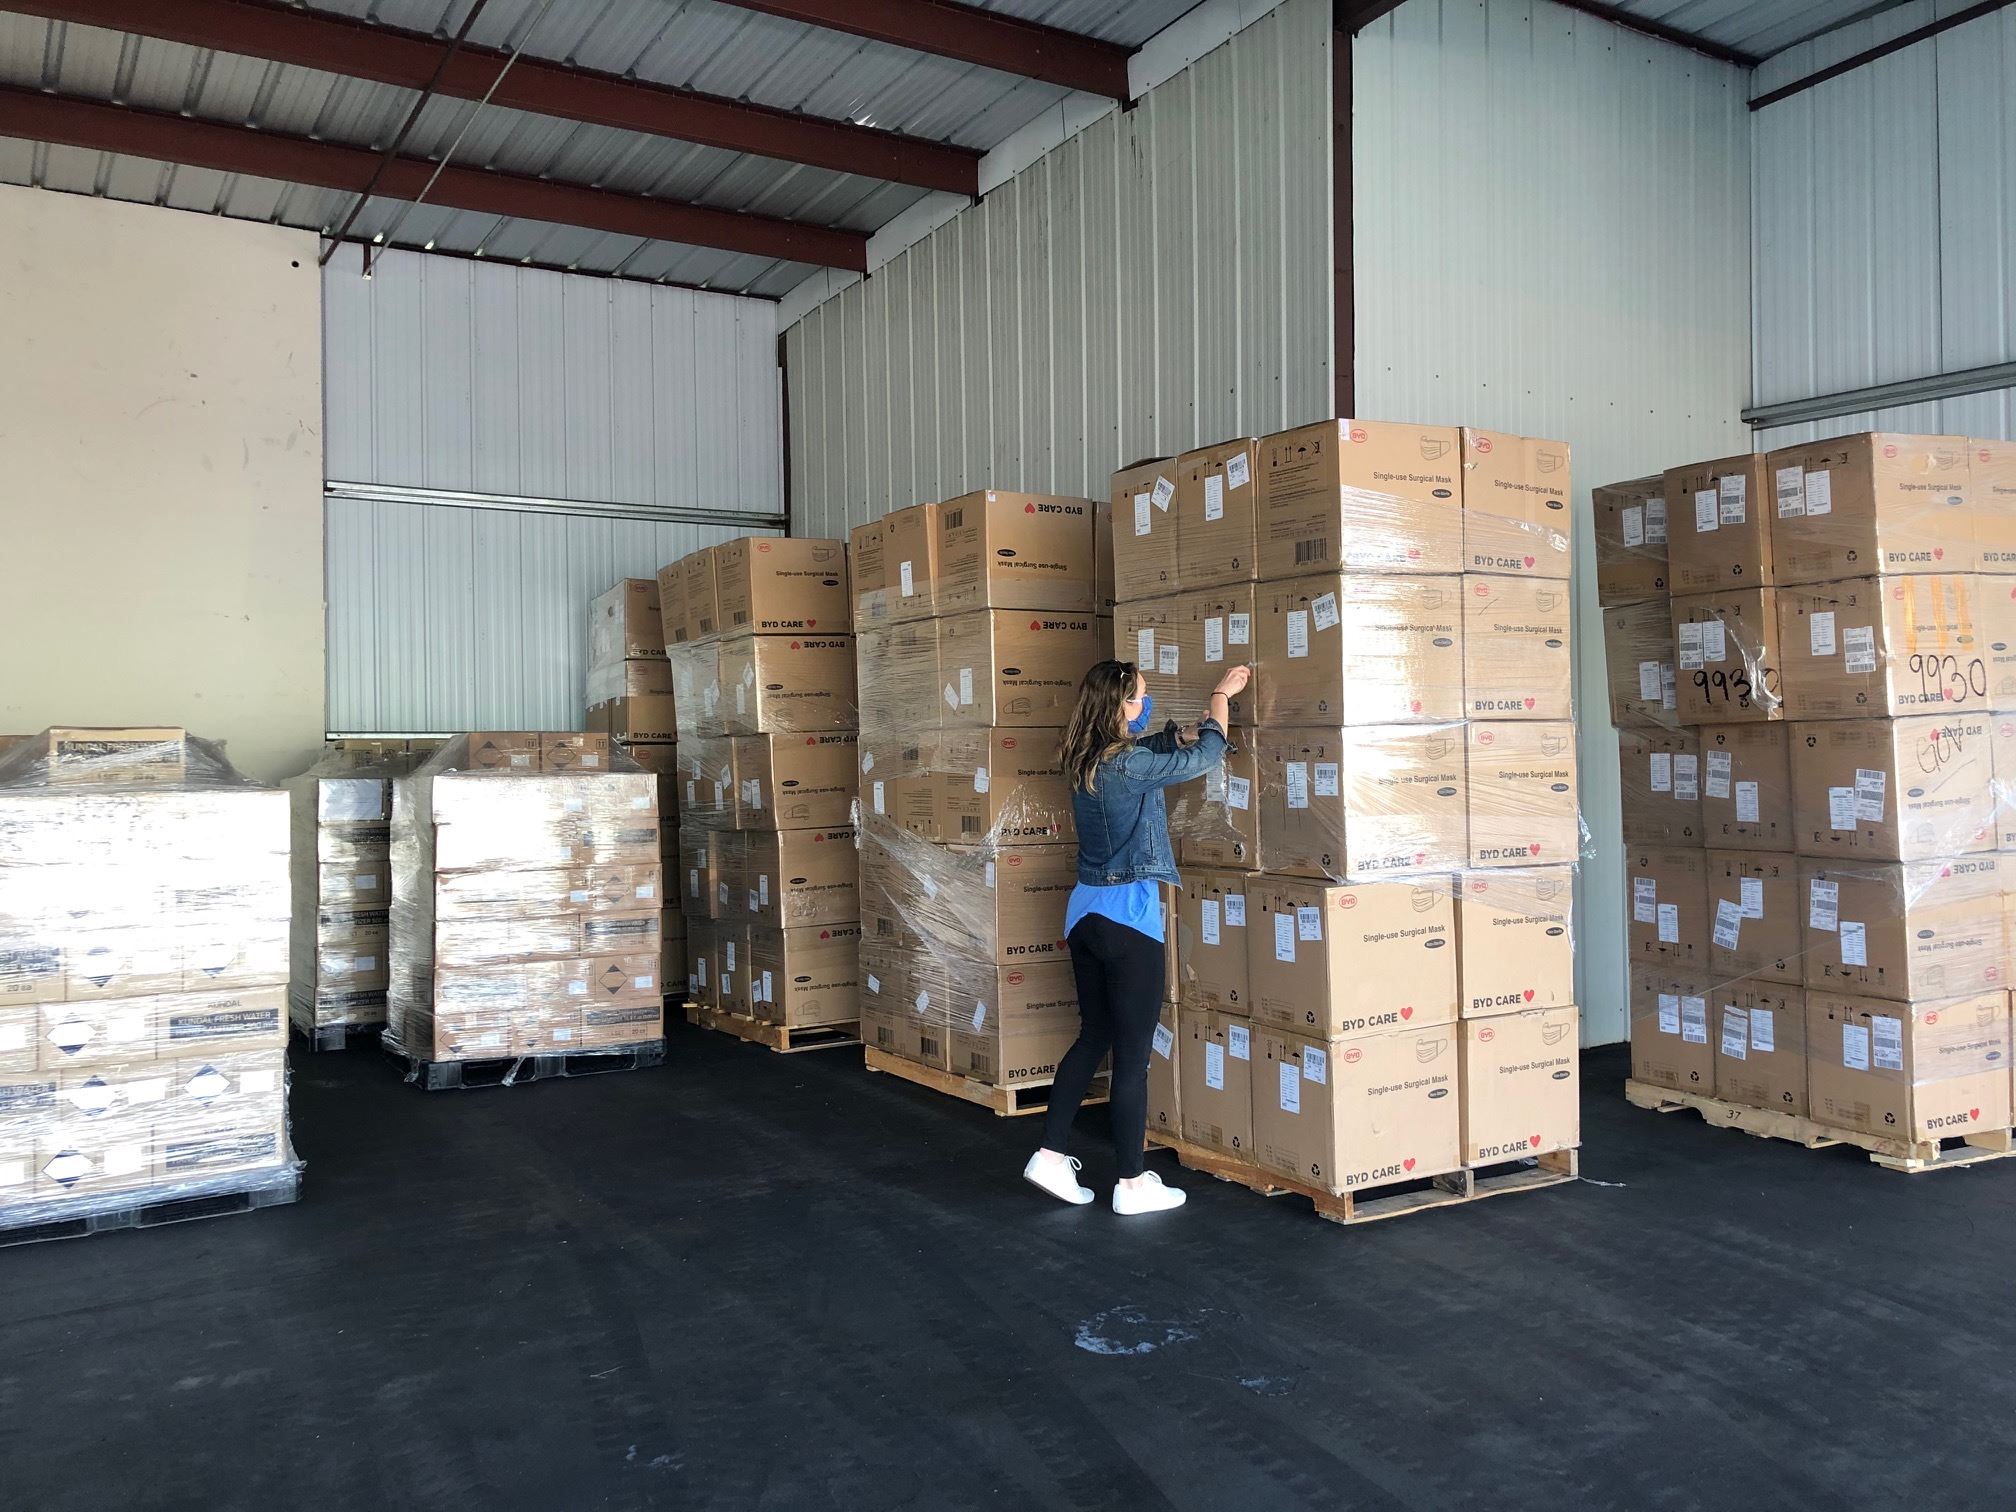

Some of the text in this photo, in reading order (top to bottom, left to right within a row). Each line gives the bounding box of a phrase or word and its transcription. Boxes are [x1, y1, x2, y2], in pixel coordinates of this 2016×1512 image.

[1373, 471, 1452, 484] Single-use Surgical Mask
[1494, 479, 1564, 496] Single-use Surgical Mask
[1899, 483, 1926, 492] Single-use
[1038, 503, 1083, 515] BYD CARE
[1474, 555, 1522, 569] BYD CARE
[1888, 552, 1932, 562] BYD CARE
[1983, 552, 2016, 562] BYD CAR
[997, 560, 1068, 571] Single-use Surgical Mask
[775, 570, 804, 578] Single-use
[803, 570, 825, 579] Surgical
[1105, 599, 1116, 607] BY
[761, 620, 804, 628] BYD CARE
[1042, 620, 1088, 631] BYD CARE
[1375, 624, 1408, 632] Se-use
[1435, 624, 1453, 633] Mask
[1493, 624, 1563, 635] Single-use Surgical Mask
[828, 640, 845, 648] BYD
[1002, 679, 1072, 688] Single-use Surgical Mask
[1909, 654, 1987, 702] 9930
[1693, 668, 1779, 704] 9930
[1898, 694, 1916, 705] BYD
[1475, 700, 1523, 711] BYD CARE
[1966, 725, 1983, 736] BYD
[819, 736, 842, 744] CARE
[1916, 718, 1963, 774] GOV
[1017, 768, 1066, 777] Single-use Surgi
[1498, 770, 1569, 781] Single-use Surgical Mask
[1413, 775, 1440, 785] Surgical
[1441, 773, 1457, 782] Mask
[796, 787, 818, 795] Surgical
[819, 786, 846, 794] Single-use
[827, 832, 850, 840] CARE
[1022, 826, 1048, 836] CARE
[2005, 833, 2016, 842] BY
[1479, 847, 1528, 860] BYD CARE
[1953, 861, 1995, 874] BYD CARE
[804, 884, 826, 893] Surgical
[1023, 884, 1074, 893] Single-use Surgi
[1492, 916, 1523, 927] Single-use
[1524, 914, 1548, 926] Surgical
[831, 929, 855, 938] CARE
[1363, 924, 1446, 943] Single-use Surgical Mask
[1006, 943, 1054, 955] BYD CARE
[809, 983, 830, 991] Surgical
[1026, 1000, 1079, 1010] Single-use Surgic
[1473, 993, 1521, 1009] BYD CARE
[243, 1011, 271, 1021] WATER
[1342, 1012, 1398, 1032] BYD CARE
[1499, 1056, 1571, 1074] Single-use Surgical Mask
[1008, 1065, 1055, 1079] BYD CARE
[1367, 1074, 1449, 1096] Single-use Surgical Mask
[1926, 1113, 1968, 1130] BYD CARE
[1479, 1140, 1528, 1159] BYD CARE
[1346, 1165, 1401, 1186] BYD CARE
